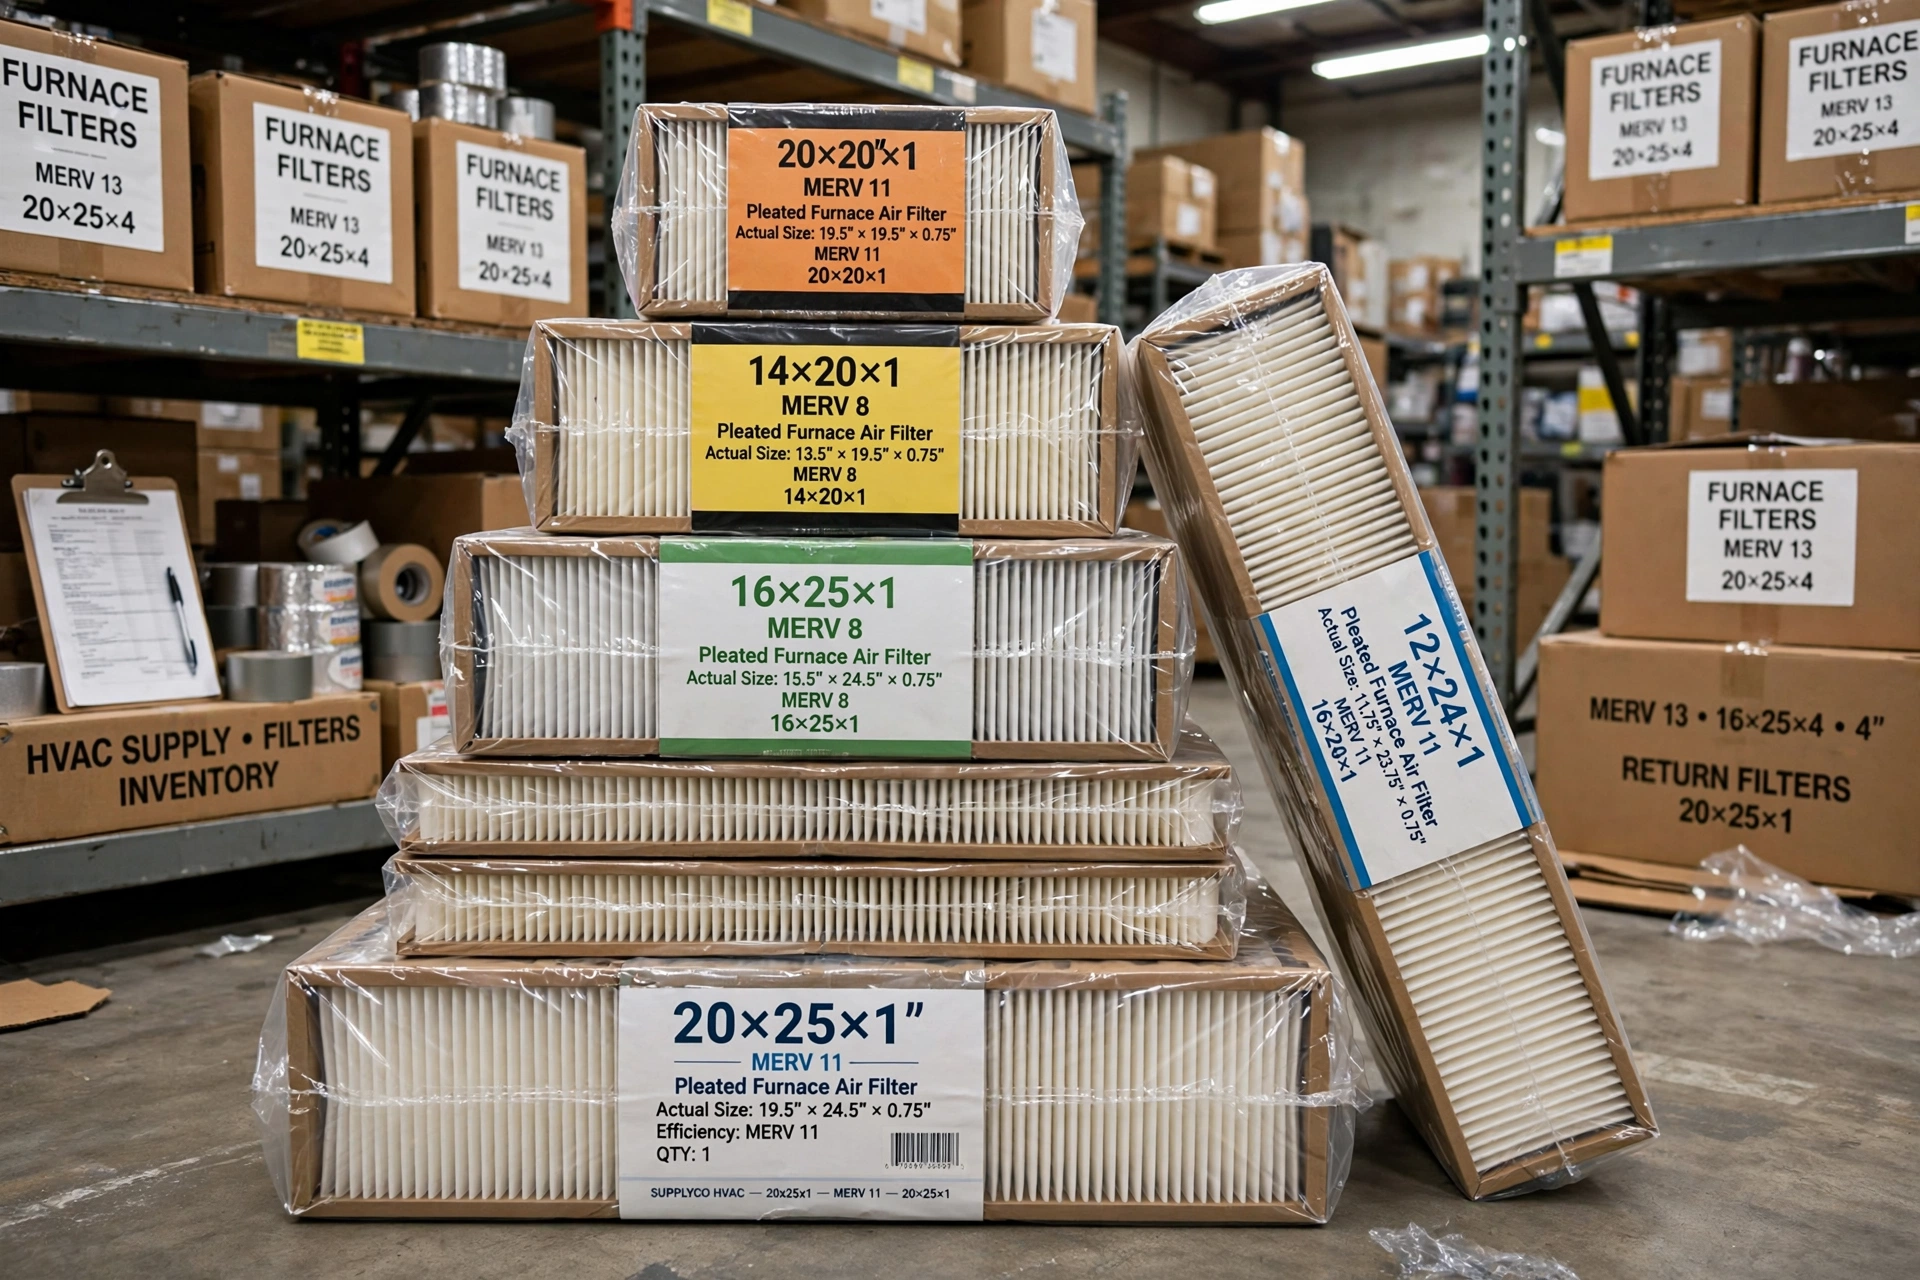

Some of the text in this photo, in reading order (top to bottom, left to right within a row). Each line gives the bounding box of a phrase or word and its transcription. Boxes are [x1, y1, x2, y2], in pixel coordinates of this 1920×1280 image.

[1800, 30, 1918, 68] FURNACE
[1599, 52, 1710, 85] FURNACE
[1810, 60, 1907, 94] FILTERS
[3, 58, 147, 114] FURNACE
[1611, 82, 1700, 111] FILTERS
[1822, 95, 1892, 116] MERV 13
[19, 100, 136, 148] FILTERS
[1620, 116, 1687, 137] MERV 13
[267, 117, 378, 162] FURNACE
[36, 162, 122, 195] MERV 13
[278, 154, 370, 192] FILTERS
[467, 154, 559, 192] FURNACE
[804, 178, 889, 197] MERV 11
[477, 187, 553, 221] FILTERS
[748, 203, 946, 221] Pleated Furnace Air Filter
[291, 207, 359, 234] MERV 13
[736, 225, 778, 239] Actual
[783, 226, 814, 239] Size:
[487, 235, 543, 258] MERV 13
[815, 247, 878, 261] MERV 11
[783, 395, 869, 416] MERV 8
[718, 423, 933, 440] Pleated Furnace Air Filter
[706, 445, 751, 459] Actual
[757, 446, 790, 460] Size:
[794, 467, 856, 482] MERV 8
[1709, 481, 1823, 502] FURNACE
[1720, 509, 1816, 530] FILTERS
[1725, 539, 1812, 559] MERV 13
[769, 617, 862, 639] MERV 8
[700, 646, 931, 665] Pleated Furnace Air Filter
[1318, 609, 1341, 653] Actual
[1340, 655, 1358, 690] Size:
[687, 670, 736, 685] Actual
[741, 671, 777, 685] Size:
[783, 692, 848, 708] MERV 8
[1388, 660, 1441, 755] MERV 11
[1341, 607, 1437, 825] Pleated Furnace Air Filter
[1591, 697, 1655, 724] MERV
[1664, 700, 1688, 727] 13
[1334, 698, 1371, 765] MERV 11
[28, 715, 360, 774] HVAC SUPPLY FILTERS
[120, 761, 278, 806] INVENTORY
[1623, 756, 1850, 802] RETURN FILTERS
[753, 1053, 840, 1071] MERV 11
[676, 1077, 917, 1095] Pleated Furnace Air Filter
[656, 1102, 708, 1117] Actual
[715, 1102, 752, 1117] Size:
[658, 1123, 817, 1143] Efficiency: MERV 11
[657, 1146, 708, 1163] QTY: 1
[651, 1188, 710, 1197] SUPPLYCO
[714, 1188, 744, 1197] HVAC
[834, 1188, 865, 1197] MERV
[870, 1188, 879, 1198] 11
